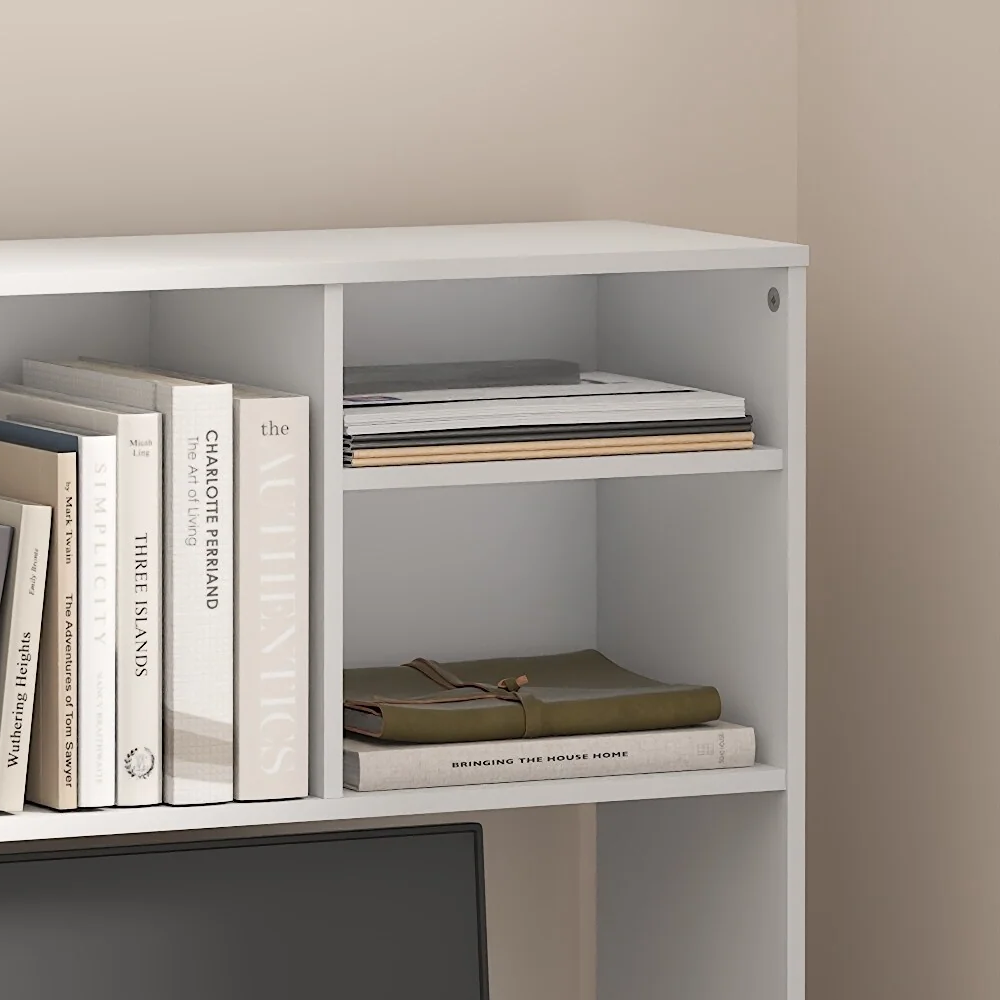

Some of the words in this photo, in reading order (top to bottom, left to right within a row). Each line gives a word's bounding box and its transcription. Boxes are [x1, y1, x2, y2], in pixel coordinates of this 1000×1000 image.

[261, 421, 289, 436] the
[188, 436, 199, 460] The
[188, 465, 199, 484] Art
[206, 430, 218, 523] CHARLOTTE
[65, 496, 73, 526] Mark
[188, 489, 199, 503] of
[185, 508, 199, 546] Living
[65, 529, 73, 564] Twain
[94, 463, 107, 645] SIMPLICITY
[135, 533, 148, 593] THREE
[206, 529, 219, 609] PERRIAND
[65, 595, 73, 617] The
[65, 620, 73, 692] Adventures
[135, 601, 148, 677] ISLANDS
[15, 631, 31, 686] Heights
[65, 695, 73, 707] of
[7, 692, 28, 768] Wuthering
[65, 711, 73, 737] Tom
[64, 742, 74, 788] Sawyer
[452, 758, 514, 768] BRINGING
[547, 753, 588, 762] HOUSE
[593, 751, 629, 759] HOME
